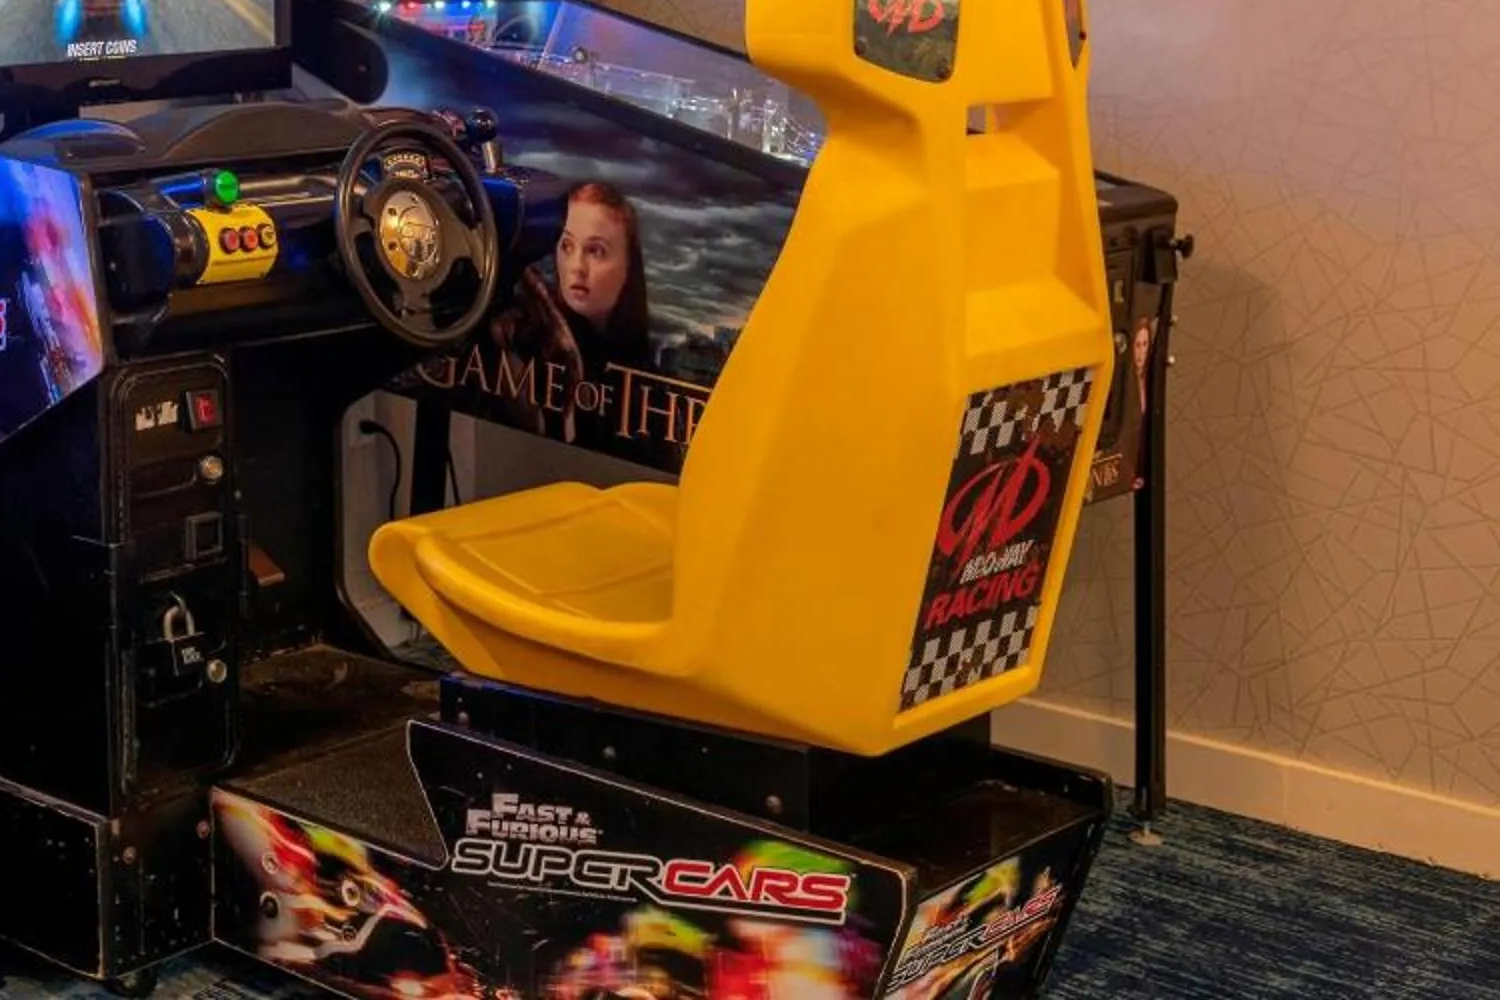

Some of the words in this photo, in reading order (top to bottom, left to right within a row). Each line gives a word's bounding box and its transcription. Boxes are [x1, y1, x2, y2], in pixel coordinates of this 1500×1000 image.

[67, 41, 105, 58] INSERT
[105, 39, 137, 56] COINS
[416, 344, 566, 413] GAME
[574, 381, 614, 418] OF
[923, 560, 1041, 631] RACING
[465, 808, 600, 845] FURIOUS
[492, 792, 576, 826] FAST
[575, 810, 592, 826] &
